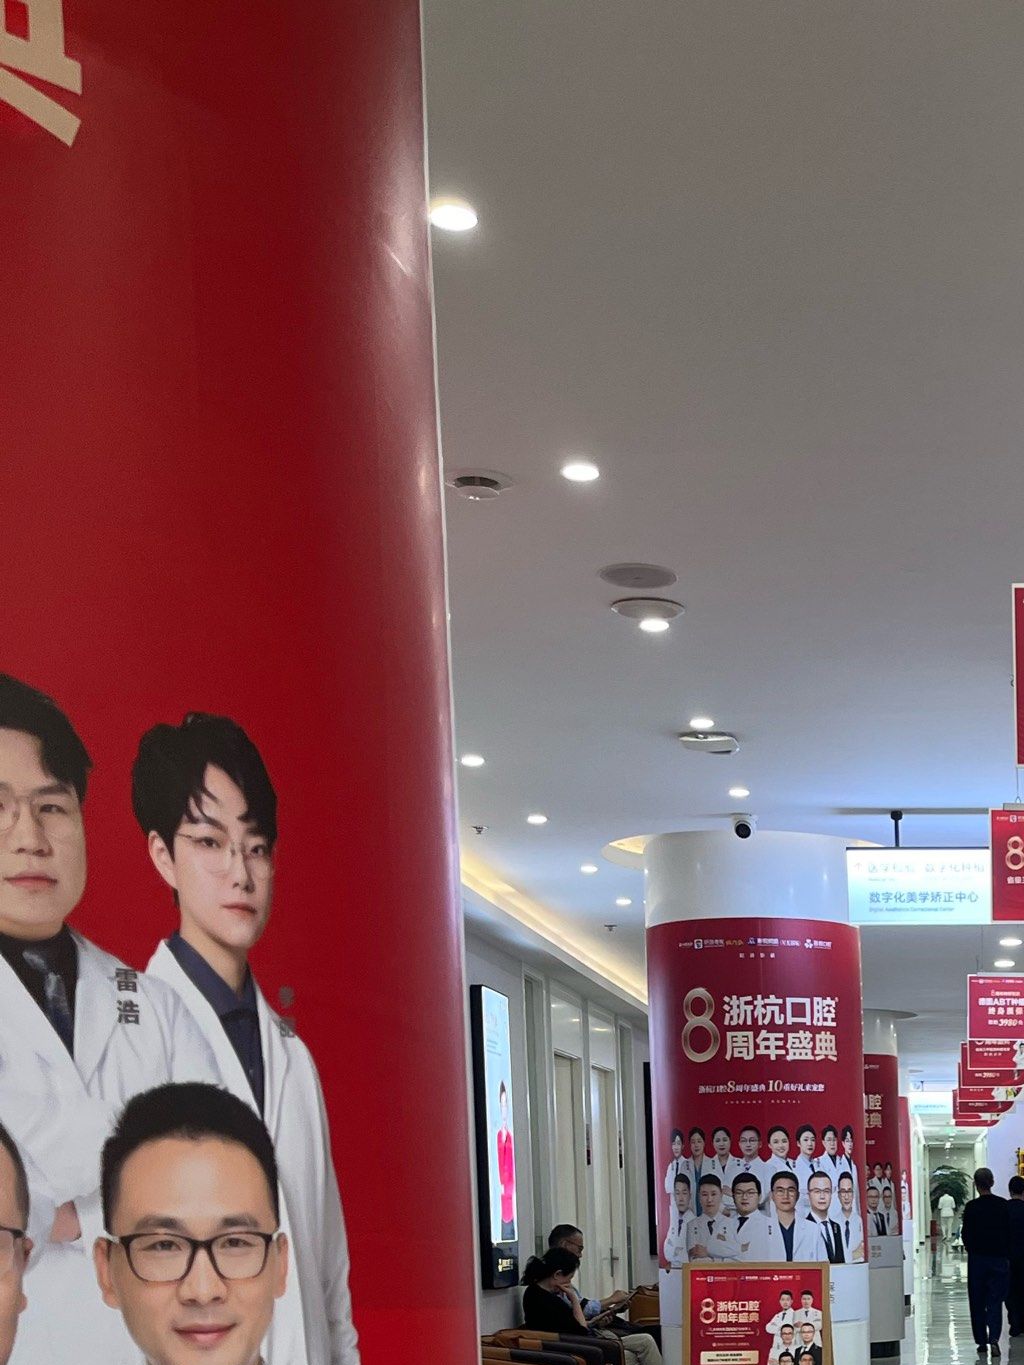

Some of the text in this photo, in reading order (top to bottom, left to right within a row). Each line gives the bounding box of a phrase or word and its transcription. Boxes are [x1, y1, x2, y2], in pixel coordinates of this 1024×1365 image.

[869, 891, 978, 903] 数字化美学矫正中心
[116, 968, 140, 1025] 雷浩
[682, 987, 721, 1062] 8
[723, 996, 837, 1026] 浙杭口腔
[725, 1031, 837, 1062] 周年盛典
[700, 1297, 716, 1324] 8
[717, 1301, 760, 1311] 浙杭口腔
[717, 1312, 759, 1323] 周年盛典
